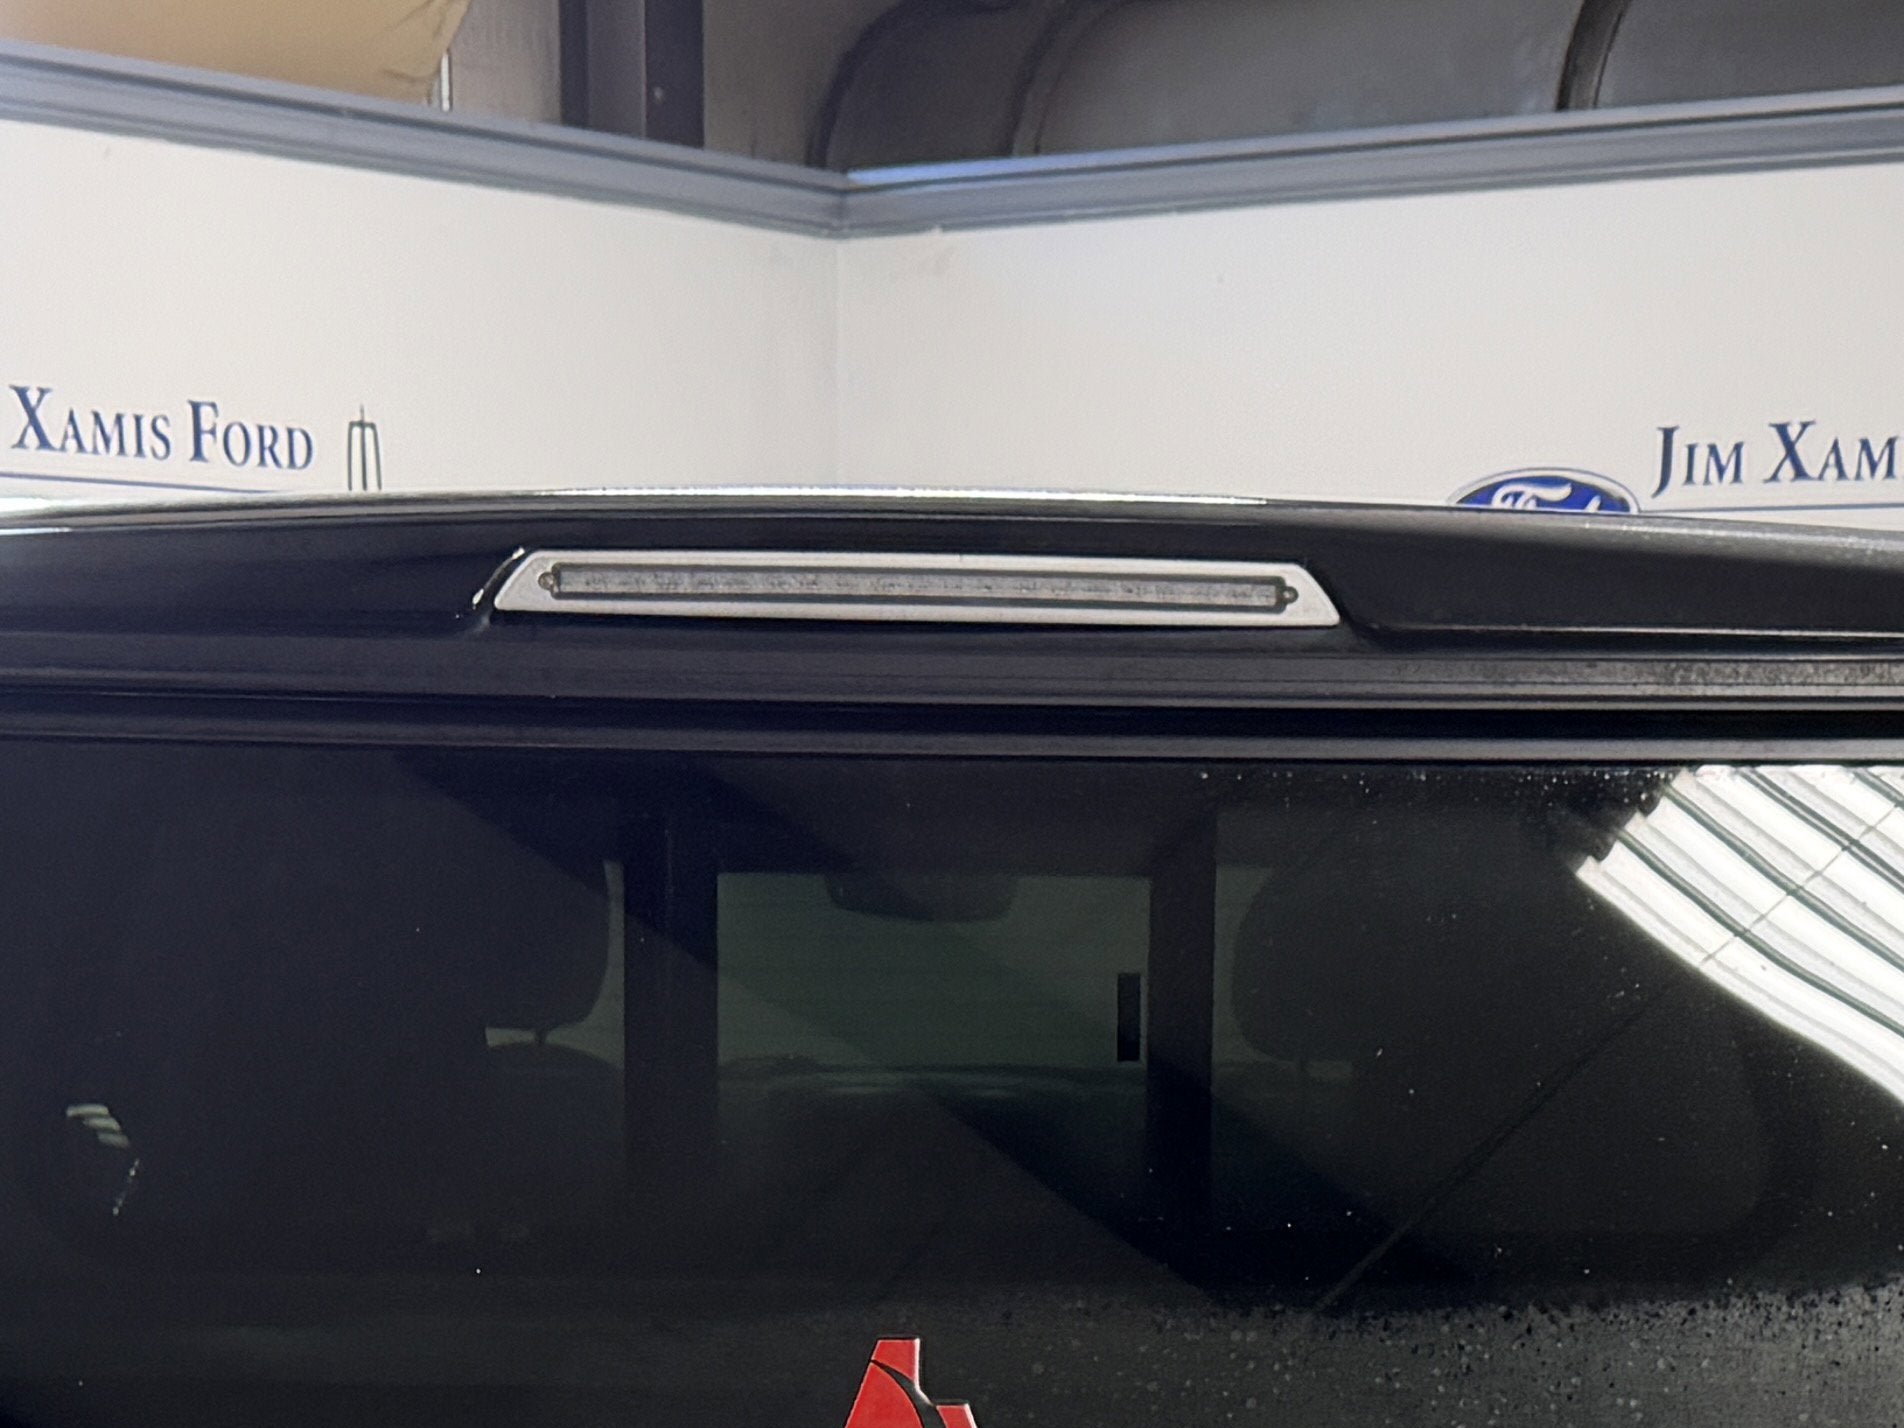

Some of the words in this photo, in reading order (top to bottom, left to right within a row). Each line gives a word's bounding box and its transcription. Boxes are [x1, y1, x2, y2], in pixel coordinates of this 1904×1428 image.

[8, 384, 171, 462] XAMIS
[186, 399, 314, 471] FORD
[1651, 425, 1745, 498] JIM
